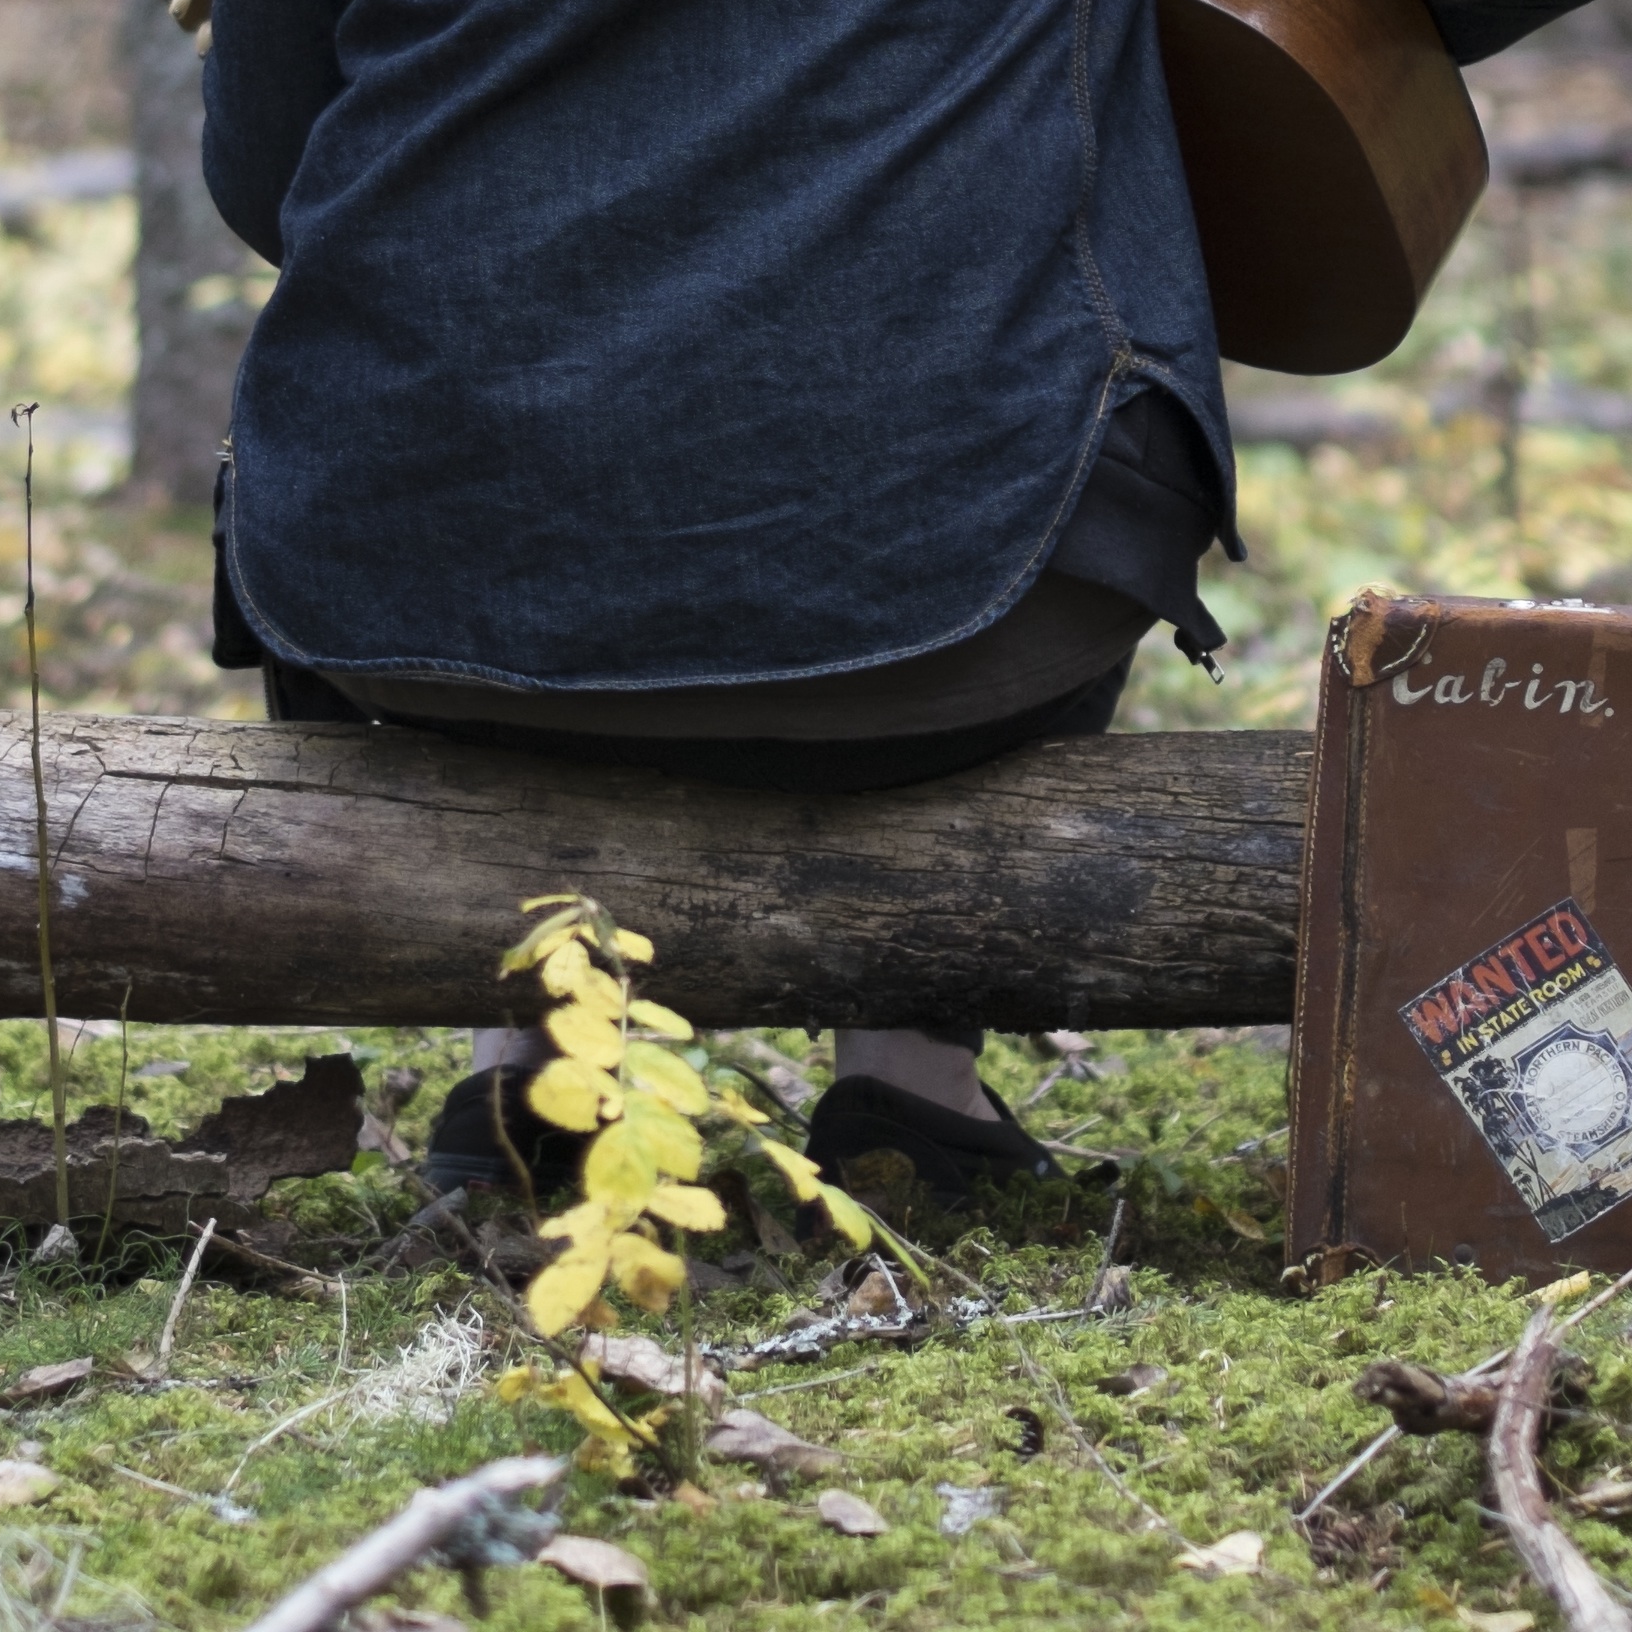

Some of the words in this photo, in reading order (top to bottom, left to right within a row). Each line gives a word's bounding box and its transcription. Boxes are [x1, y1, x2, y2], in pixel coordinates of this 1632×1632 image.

[1411, 911, 1588, 1045] WANTED
[1456, 1032, 1480, 1055] IN
[1477, 997, 1532, 1039] STATE
[1529, 962, 1587, 1003] ROOM
[1526, 1041, 1580, 1085] NORTHERN
[1585, 1044, 1624, 1083] PACIFIC
